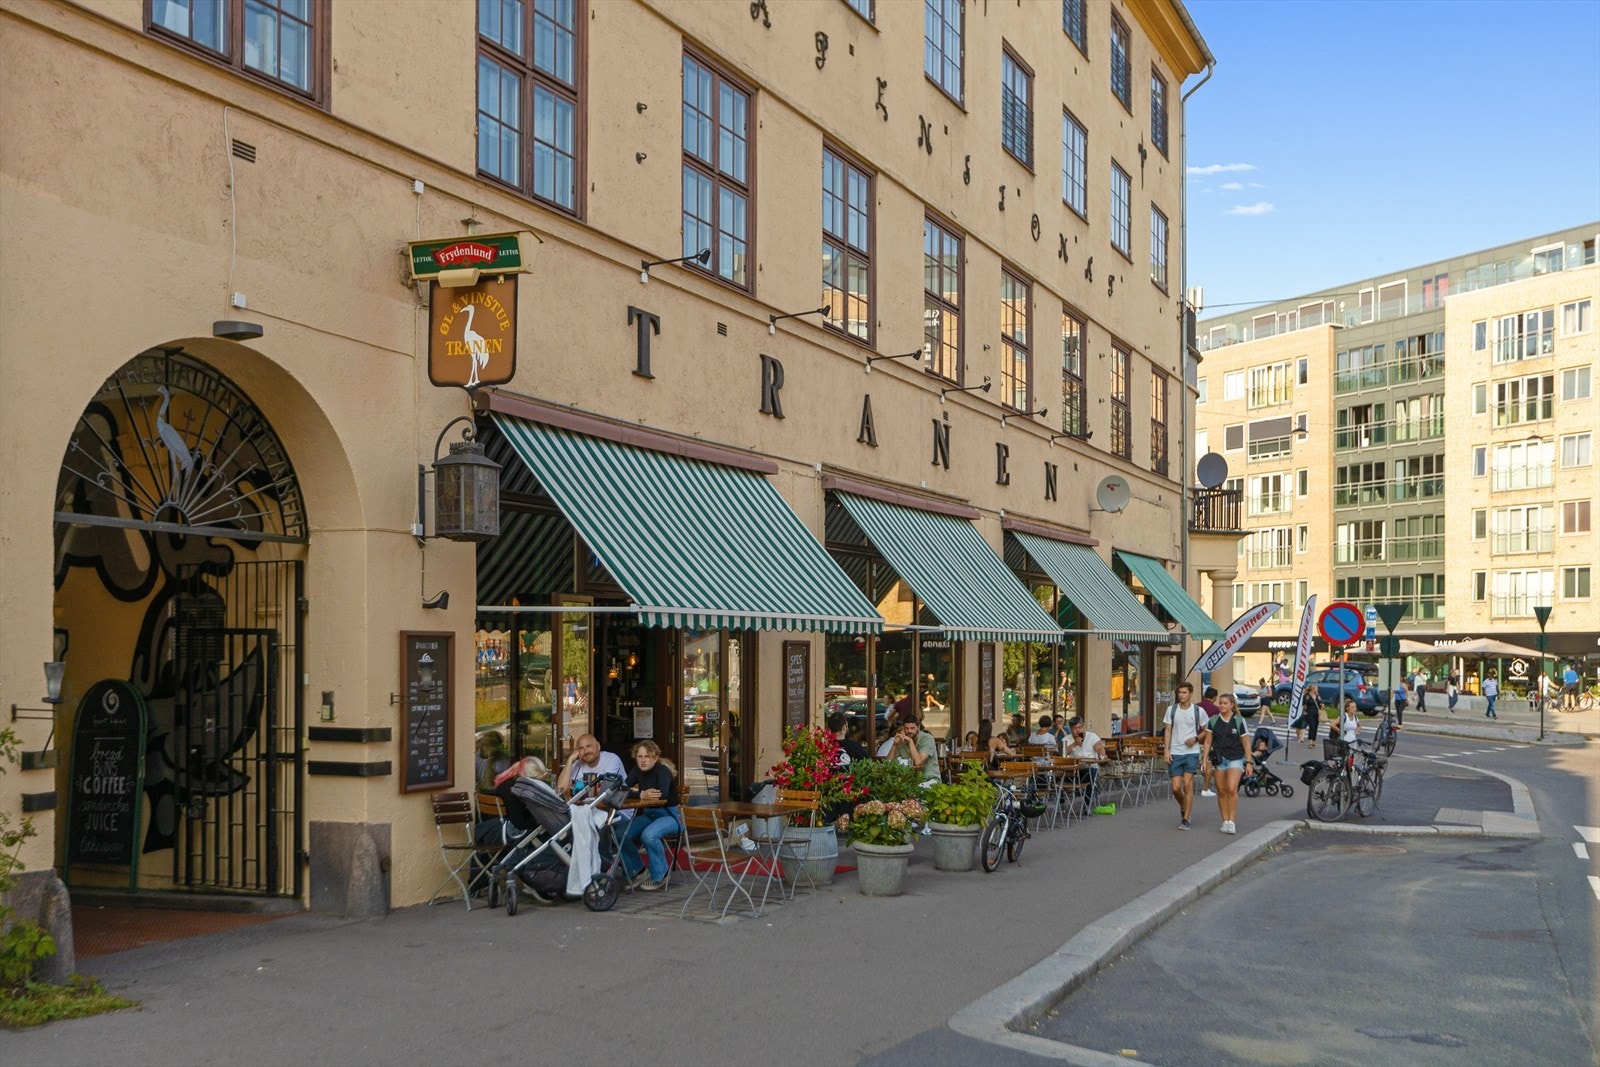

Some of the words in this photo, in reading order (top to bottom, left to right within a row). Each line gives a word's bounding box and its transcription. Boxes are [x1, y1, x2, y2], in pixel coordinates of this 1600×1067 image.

[439, 244, 493, 264] Frydenlund
[439, 313, 454, 336] ØL
[460, 291, 511, 332] VINSTUE
[445, 338, 503, 356] TRANEN
[627, 305, 1059, 502] TRANEN
[83, 776, 126, 794] COFFEE
[85, 813, 120, 832] JUICE
